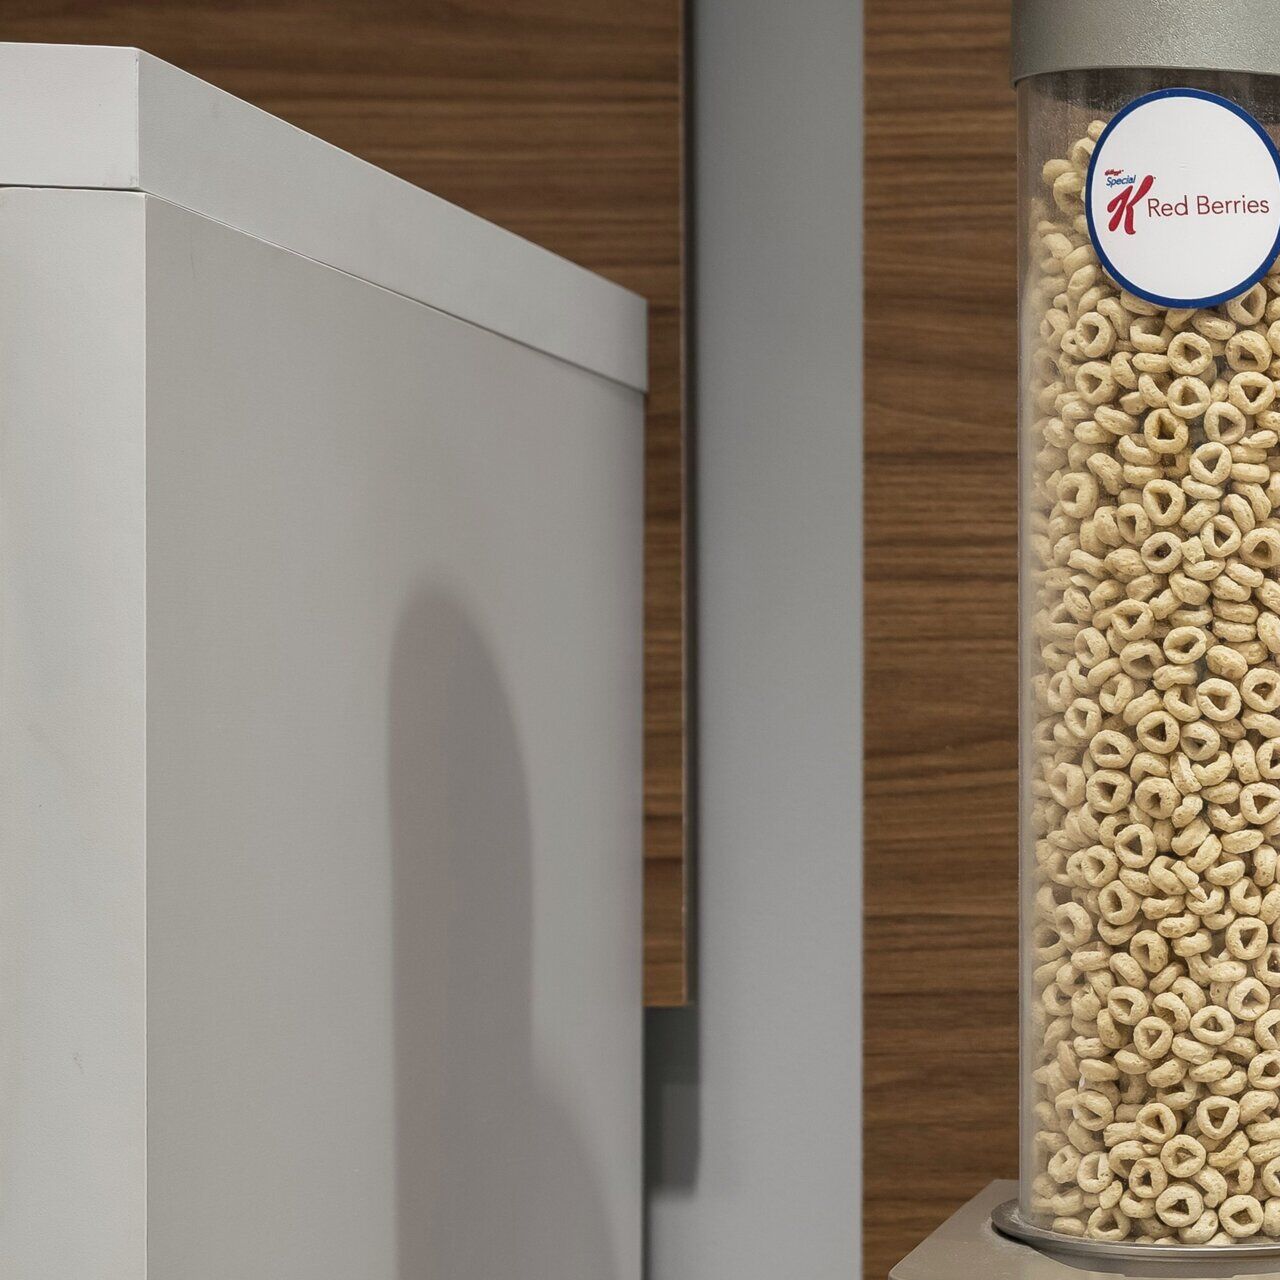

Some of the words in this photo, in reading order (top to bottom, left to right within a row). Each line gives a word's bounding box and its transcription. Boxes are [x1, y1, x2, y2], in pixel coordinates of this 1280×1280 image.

[1105, 174, 1136, 188] Special
[1107, 175, 1154, 235] K
[1147, 195, 1189, 217] Red
[1196, 194, 1270, 215] Berries
